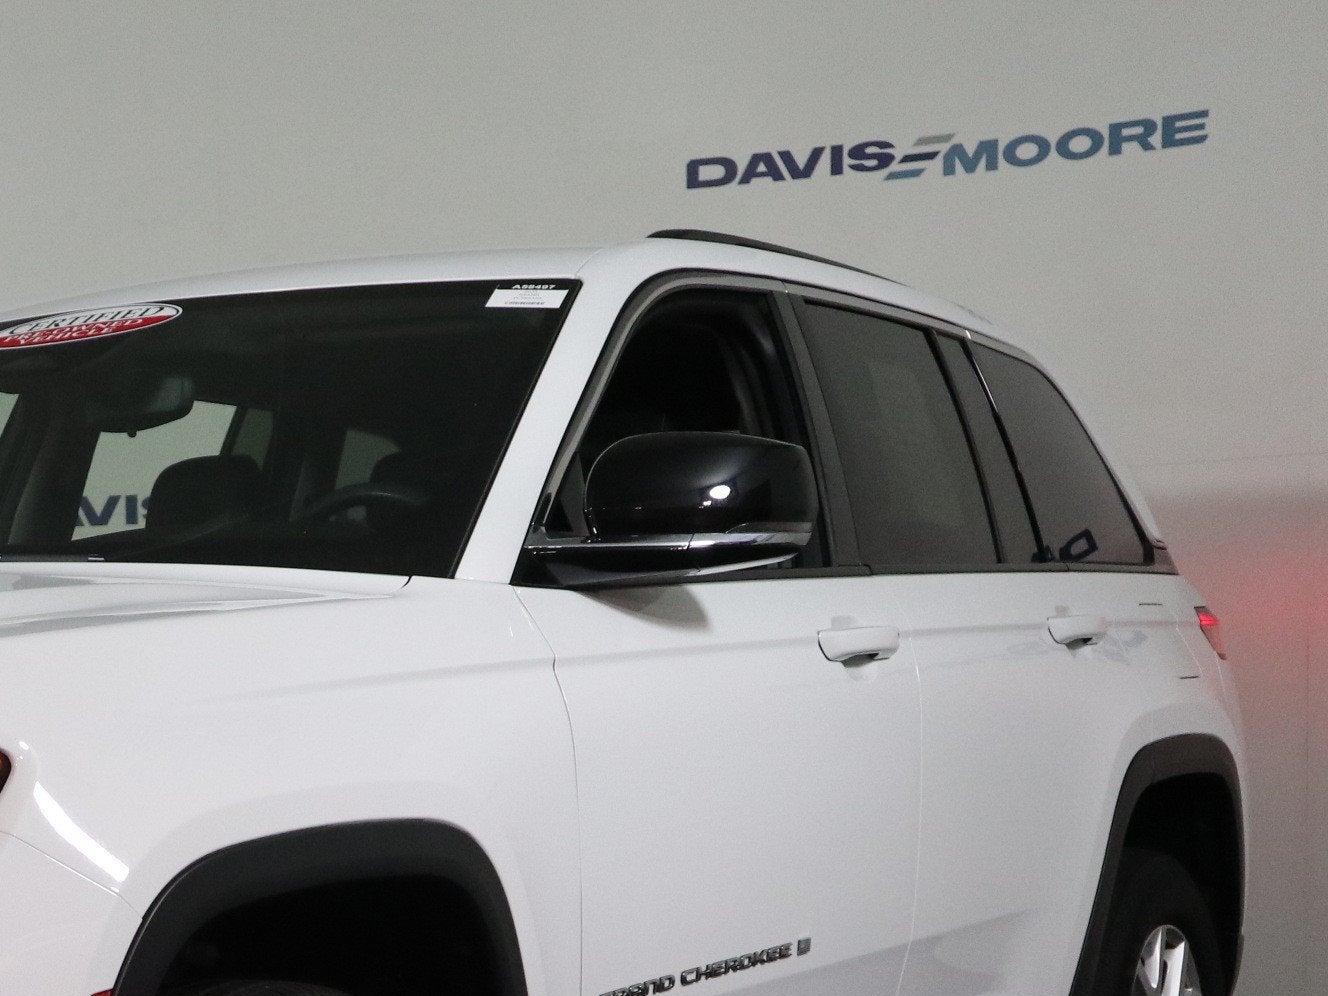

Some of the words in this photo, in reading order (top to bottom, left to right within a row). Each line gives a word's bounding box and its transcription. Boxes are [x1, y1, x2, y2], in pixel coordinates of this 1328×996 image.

[686, 139, 896, 190] DAVIS
[942, 108, 1210, 177] MOORE
[9, 306, 165, 335] CERTIFIED
[680, 941, 793, 986] CHEROKEE
